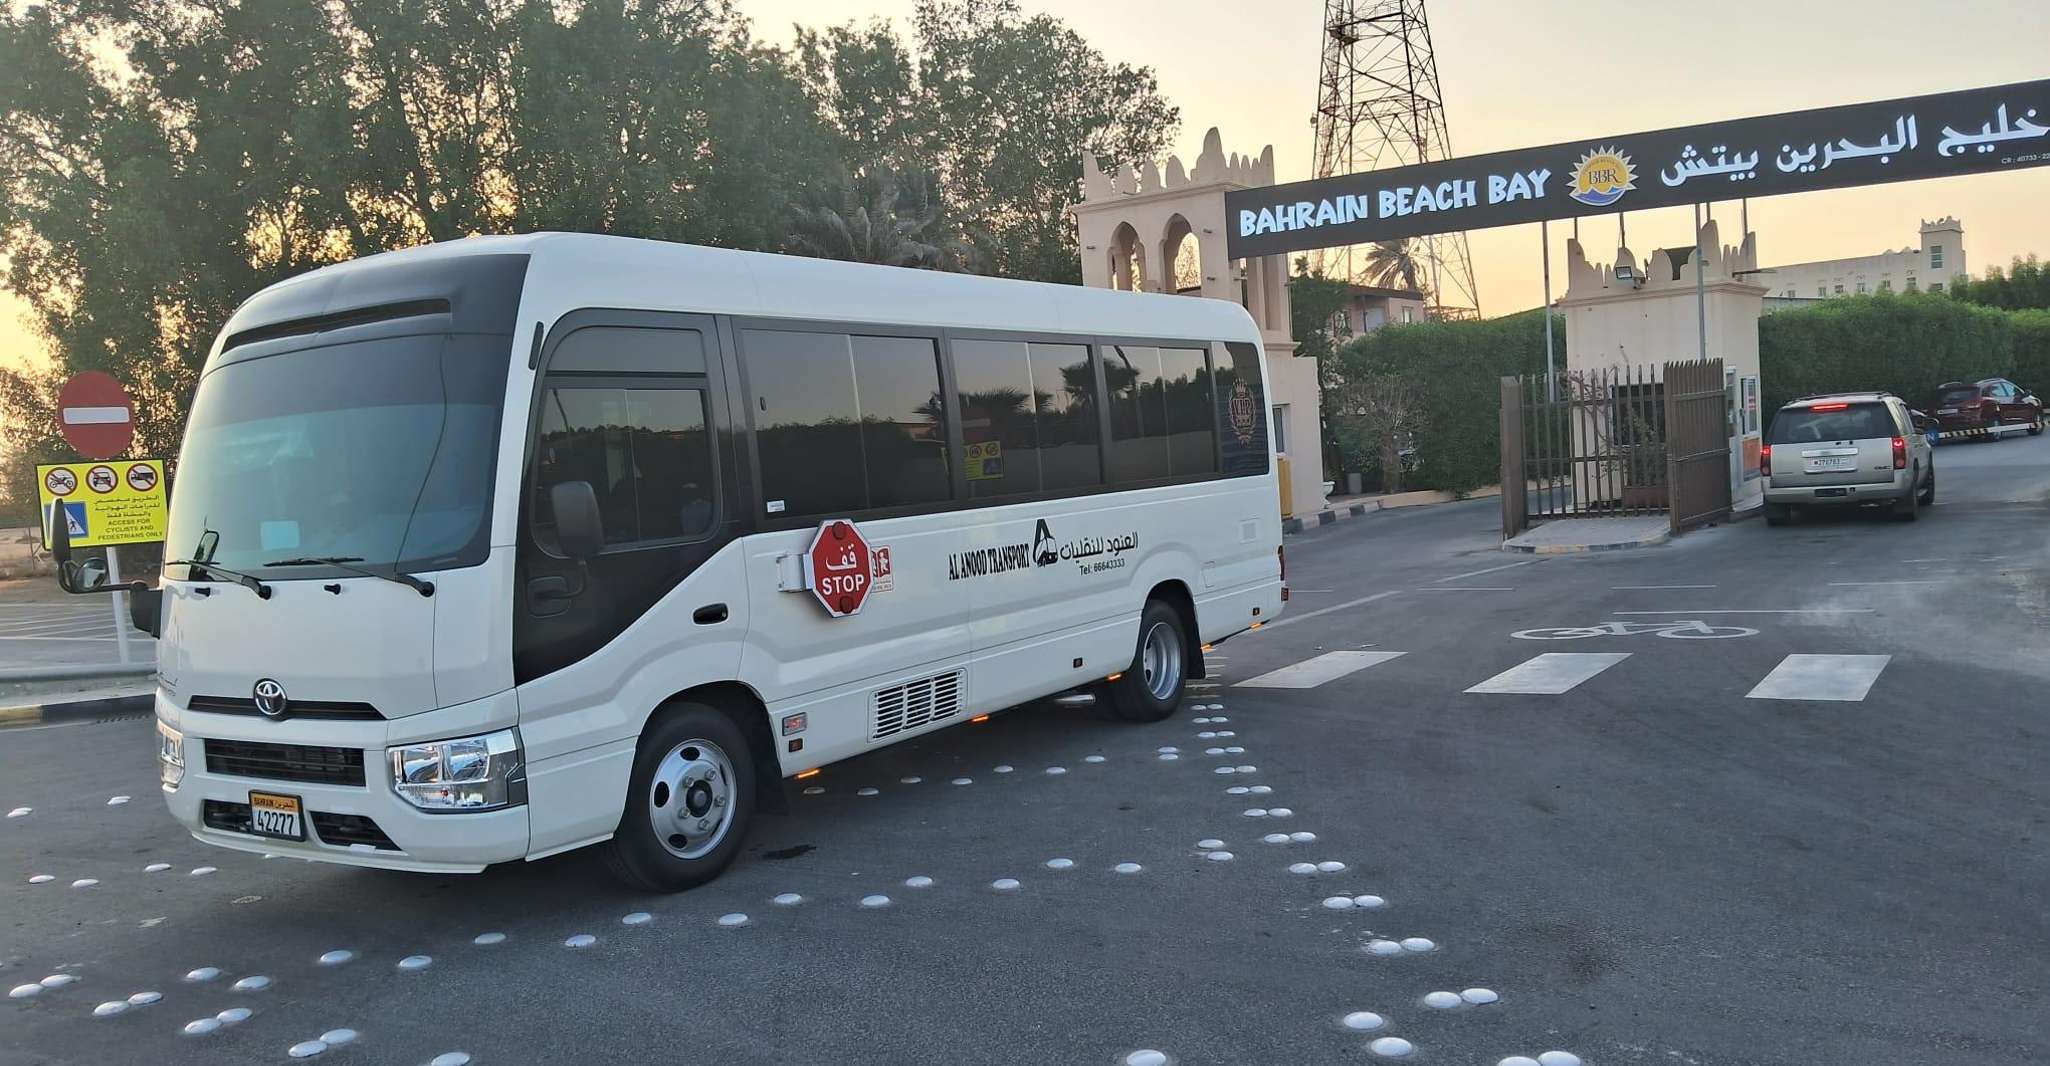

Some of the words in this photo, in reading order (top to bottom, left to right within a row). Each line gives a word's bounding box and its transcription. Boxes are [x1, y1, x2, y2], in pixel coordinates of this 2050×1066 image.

[1776, 114, 1918, 173] البحرين
[1937, 103, 2050, 158] خليج
[1588, 168, 1622, 185] BBR
[1661, 144, 1759, 188] بيتش
[1240, 194, 1369, 238] BAHRAIN
[1378, 180, 1477, 219] BEACH
[1488, 168, 1552, 204] BAY
[98, 532, 144, 540] PEDESTRIANS
[1060, 536, 1104, 563] للنقليات
[1107, 531, 1139, 557] العنود
[825, 543, 857, 571] قف
[949, 552, 960, 581] AL
[961, 548, 987, 578] ANOOD
[987, 543, 1030, 574] TRANSPORT
[822, 574, 864, 595] STOP
[258, 810, 294, 834] 42277
